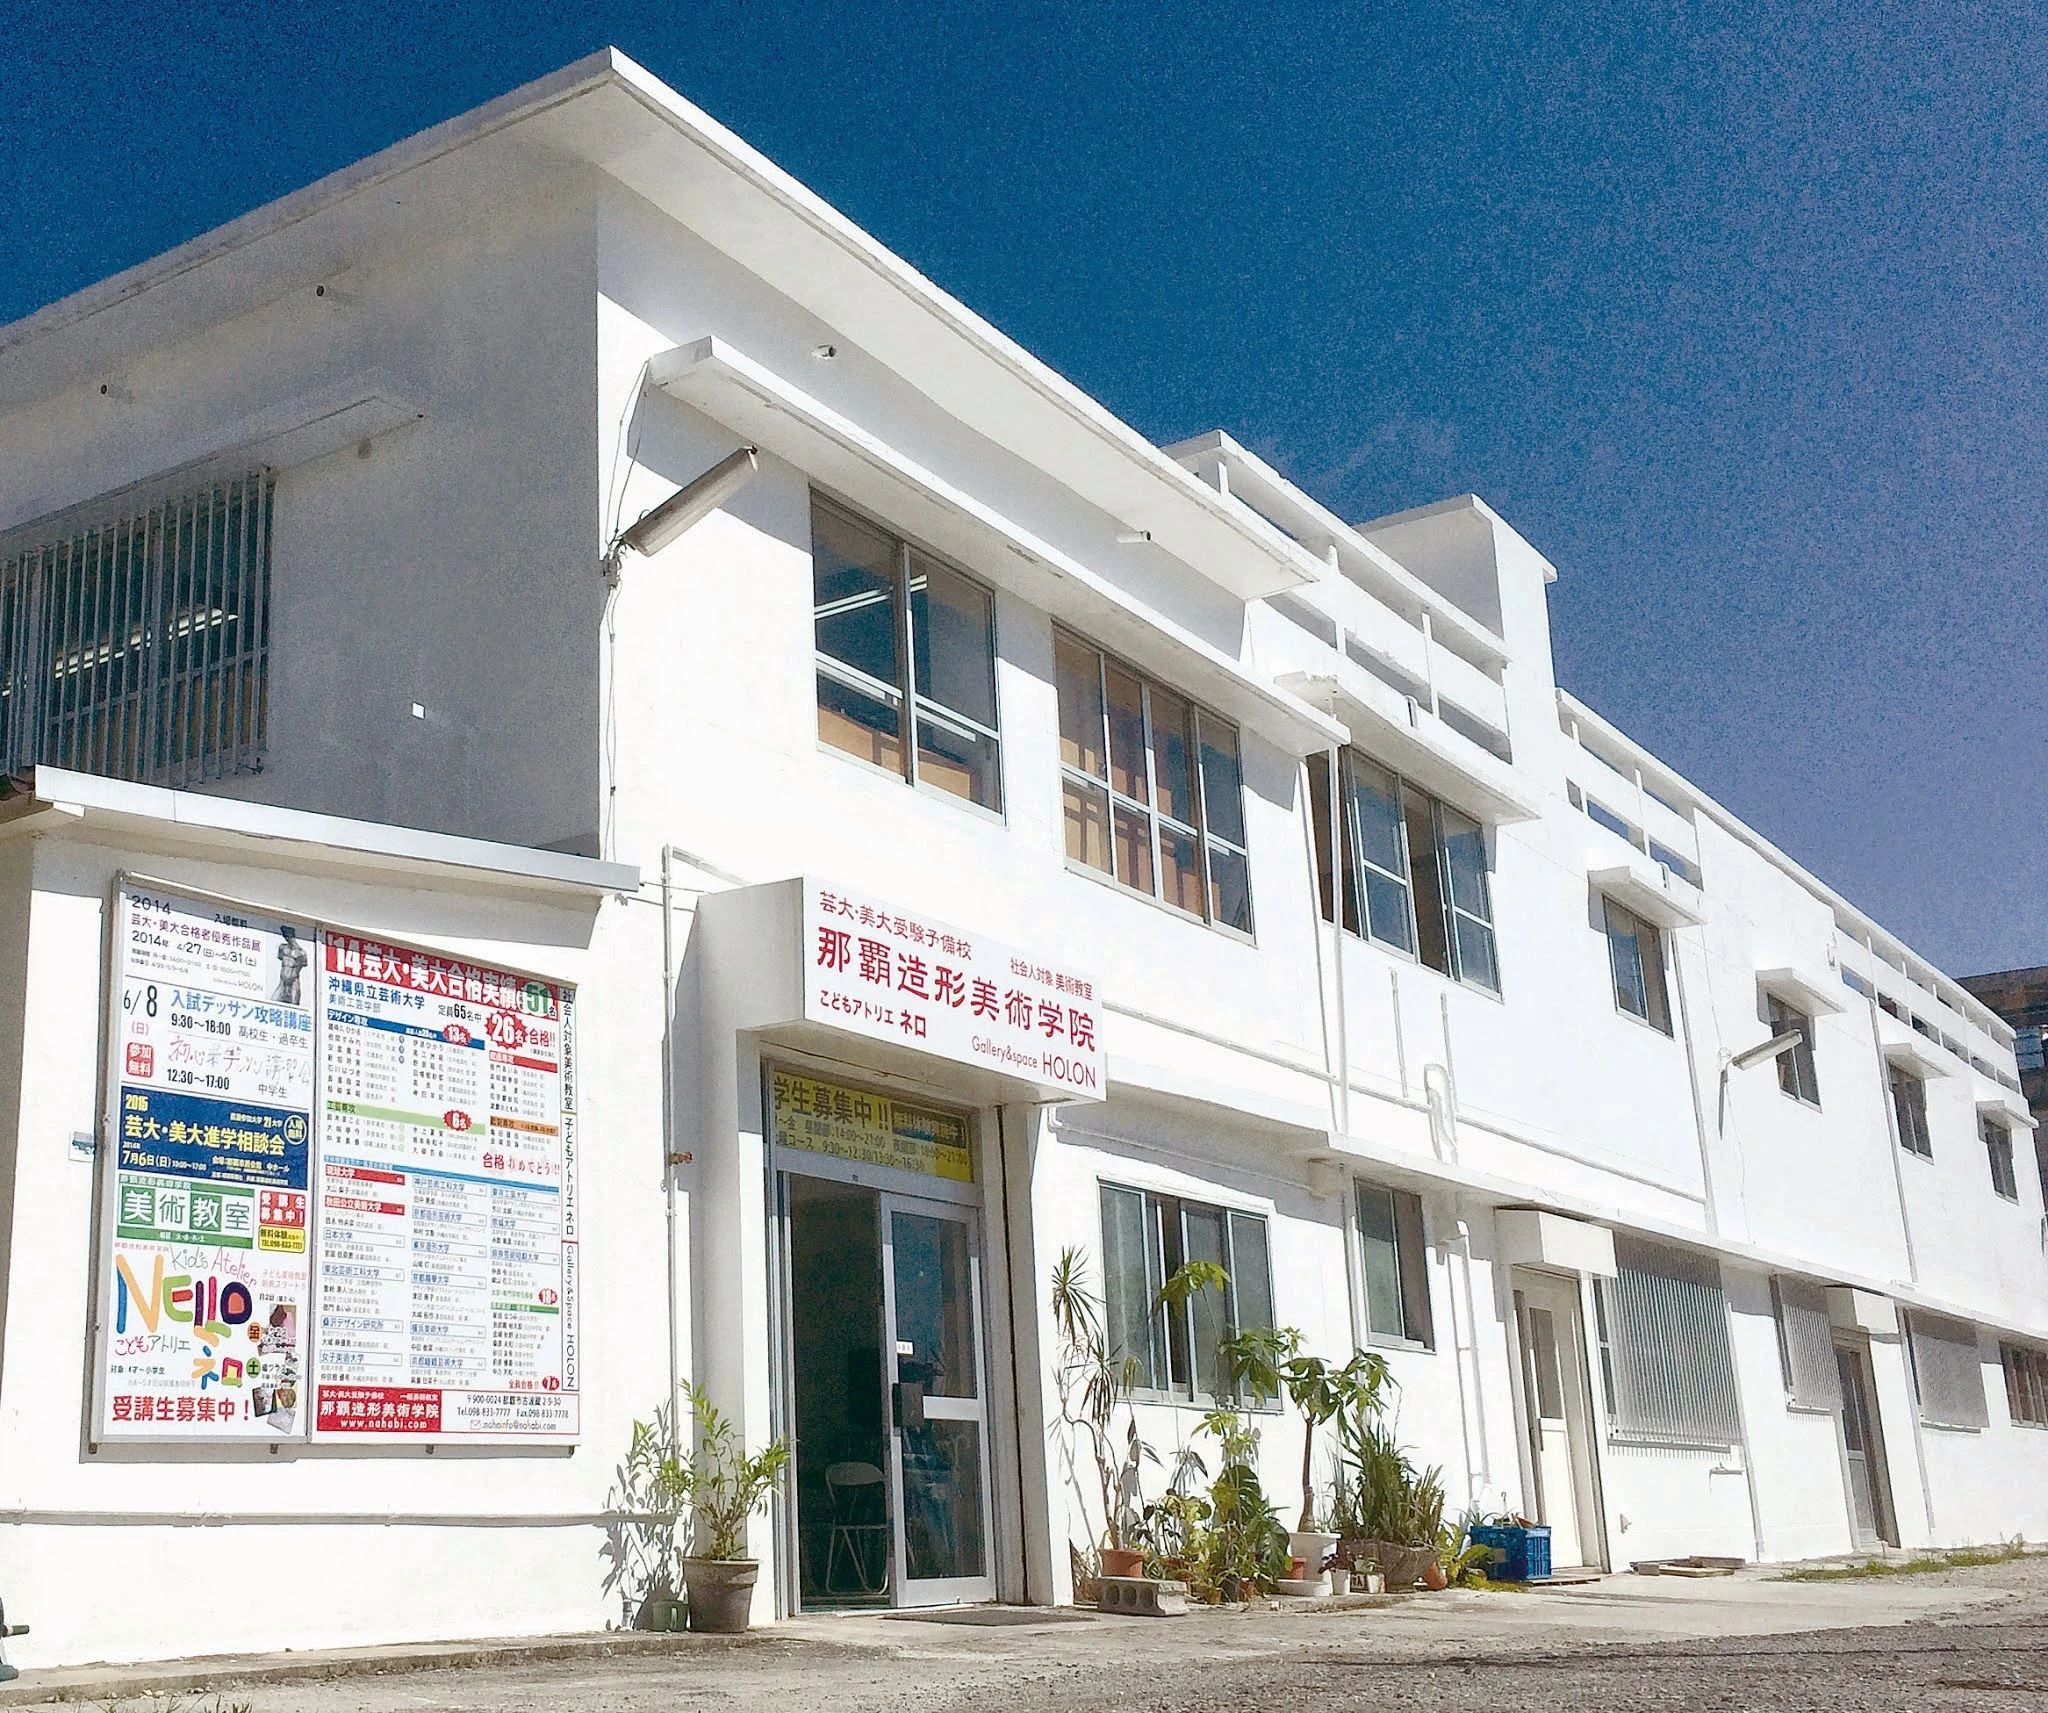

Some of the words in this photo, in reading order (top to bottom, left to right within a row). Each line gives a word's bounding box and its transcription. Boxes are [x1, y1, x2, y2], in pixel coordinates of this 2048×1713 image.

[132, 895, 171, 914] 2014
[132, 930, 169, 947] 2014年
[123, 984, 158, 1017] 6/8
[328, 976, 425, 1010] 沖縄県立芸術大学
[817, 926, 1095, 1052] 那覇造形美術学院
[171, 989, 312, 1032] 入試デッサン攻略講座
[820, 989, 894, 1026] こどもアトリエ
[129, 1043, 152, 1060] 参加
[972, 1035, 1038, 1069] Gallery&space
[1043, 1052, 1096, 1088] HOLON
[128, 1059, 152, 1076] 無料
[125, 1094, 148, 1112] 2015
[258, 1083, 288, 1099] 中学生
[125, 1114, 285, 1156] 芸大・美大進学相談会
[483, 1152, 505, 1170] 合格
[122, 1189, 250, 1231] 美術教室
[212, 1246, 257, 1288] Atelier
[115, 1335, 191, 1356] こどもアトリエ
[566, 1334, 575, 1388] HOLON
[320, 1400, 440, 1418] 那覇造形美術学院
[340, 1418, 428, 1430] www.nahabi.com
